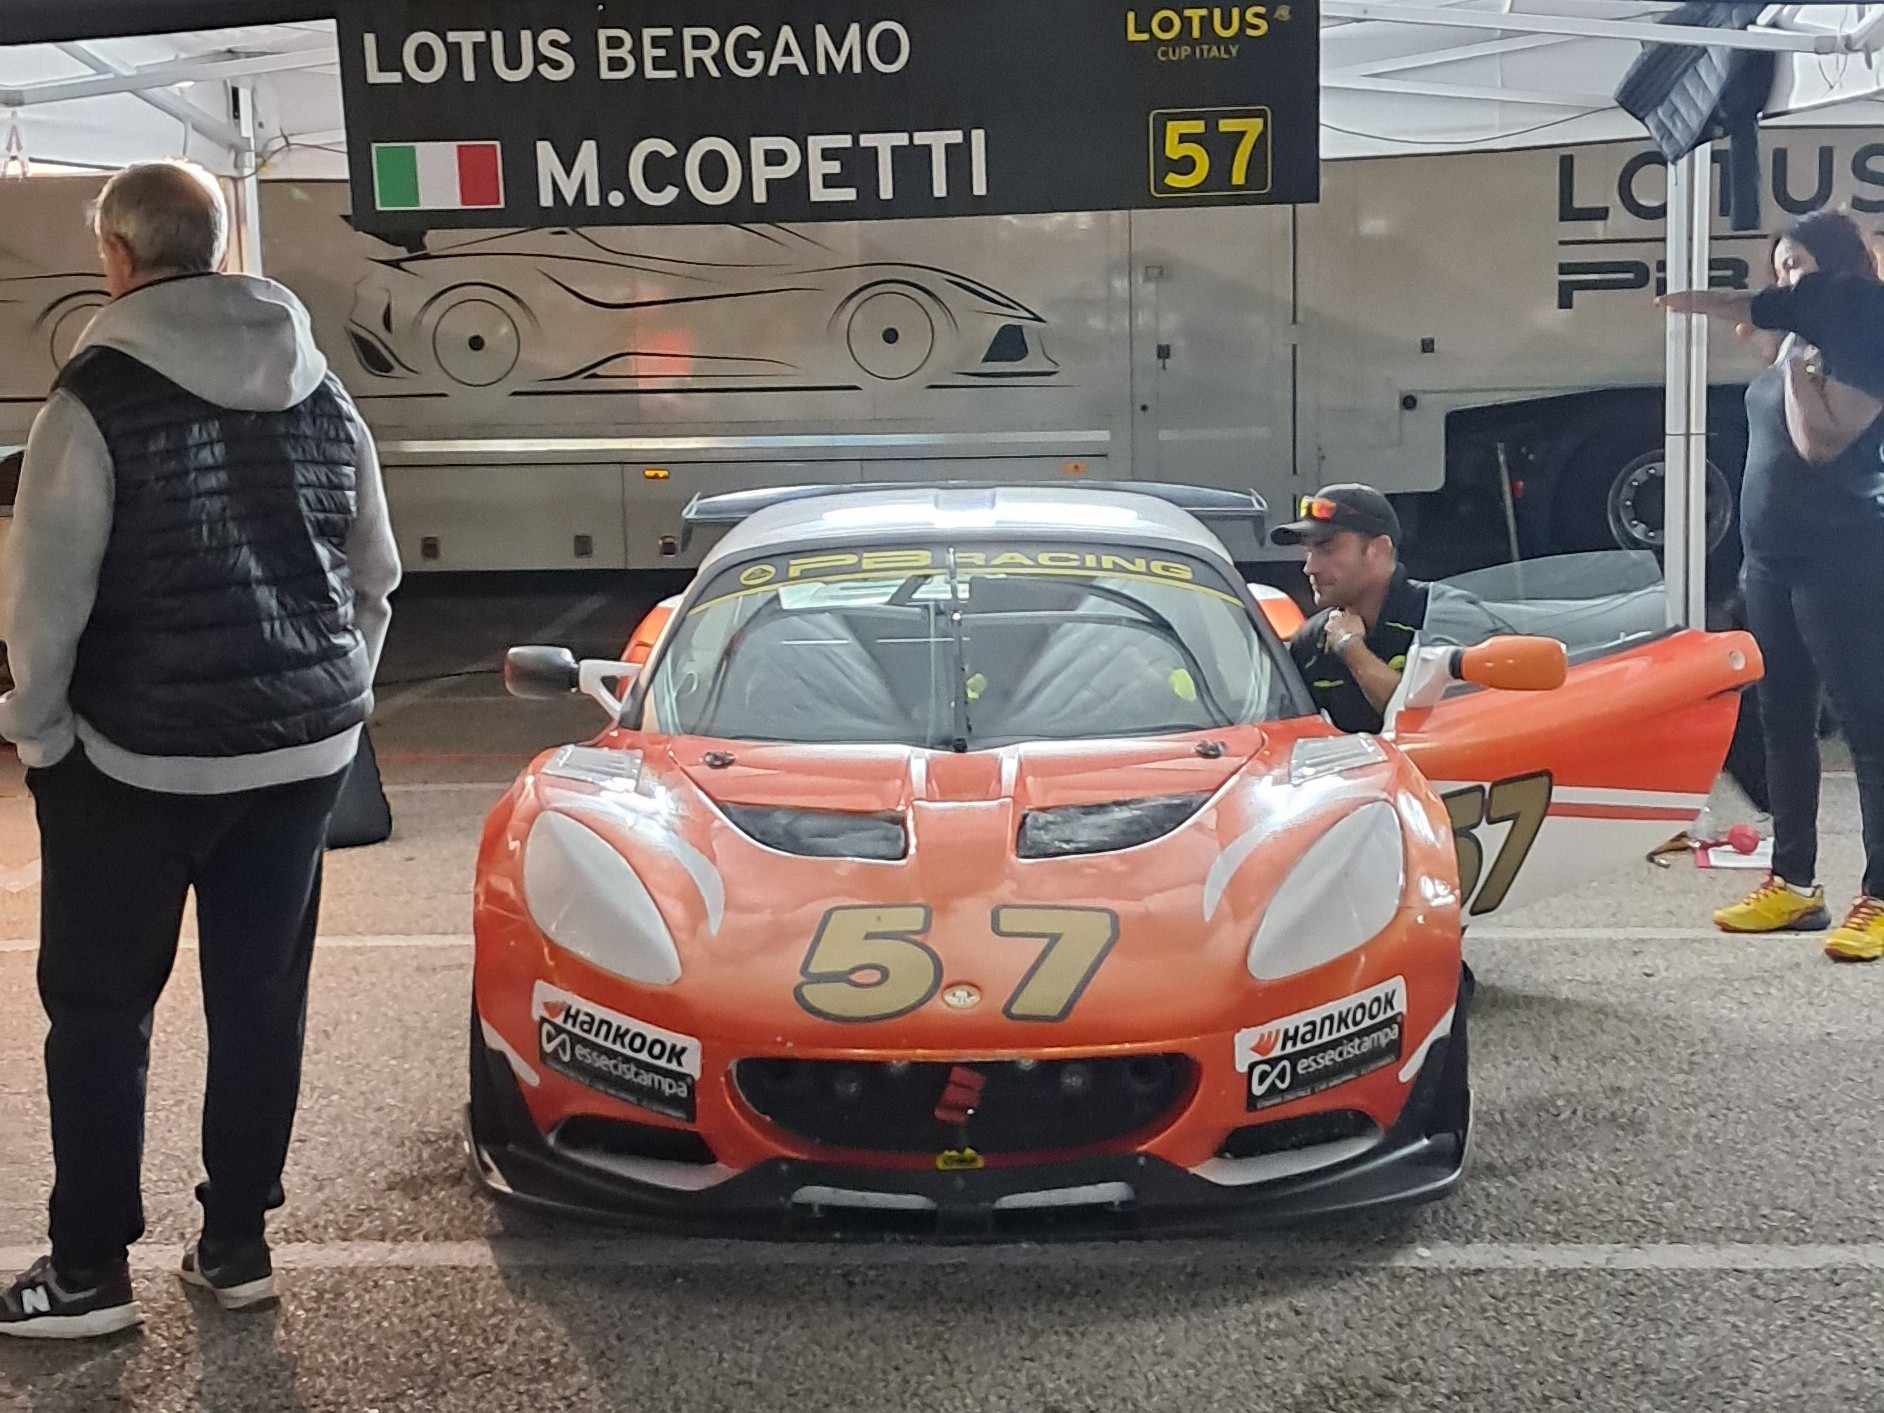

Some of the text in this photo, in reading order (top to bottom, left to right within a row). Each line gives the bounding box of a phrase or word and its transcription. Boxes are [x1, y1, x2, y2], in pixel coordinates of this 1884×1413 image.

[1126, 5, 1269, 41] LOTUS
[363, 20, 911, 84] LOTUS BERGAMO
[1157, 44, 1240, 61] CUP ITALY
[536, 128, 988, 208] M.COPETTI
[1163, 118, 1264, 188] 57
[788, 550, 1194, 581] PB RACING
[21, 1284, 51, 1315] N
